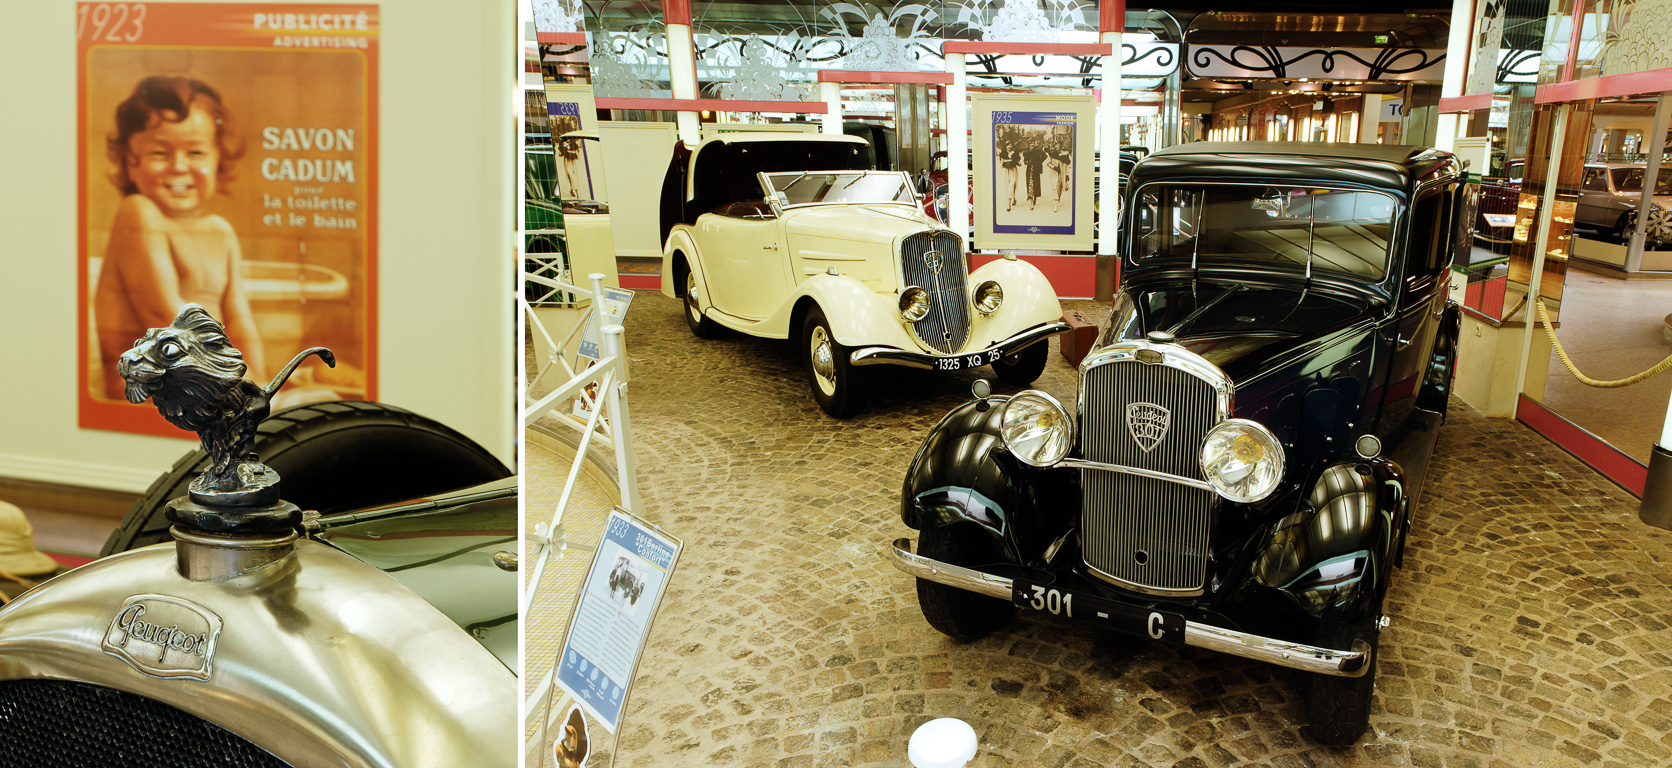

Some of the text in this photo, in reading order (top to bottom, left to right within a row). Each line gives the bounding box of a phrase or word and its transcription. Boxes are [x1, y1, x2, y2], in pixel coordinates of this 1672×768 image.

[77, 4, 146, 43] 1923
[253, 11, 369, 31] PUBLICITÉ
[272, 36, 369, 49] ADVERTISING
[992, 111, 1013, 124] 1935
[262, 126, 355, 152] SAVON
[261, 158, 356, 184] CADUM
[293, 186, 326, 197] pour
[263, 194, 357, 212] la toilette
[262, 213, 357, 230] et le bain
[939, 349, 1000, 370] 1325 XQ 25
[1129, 405, 1167, 425] Peugeot
[1135, 423, 1161, 440] 301
[607, 517, 630, 539] 1933
[1030, 584, 1073, 618] 301
[1147, 611, 1164, 640] C
[118, 603, 207, 664] Peugeot
